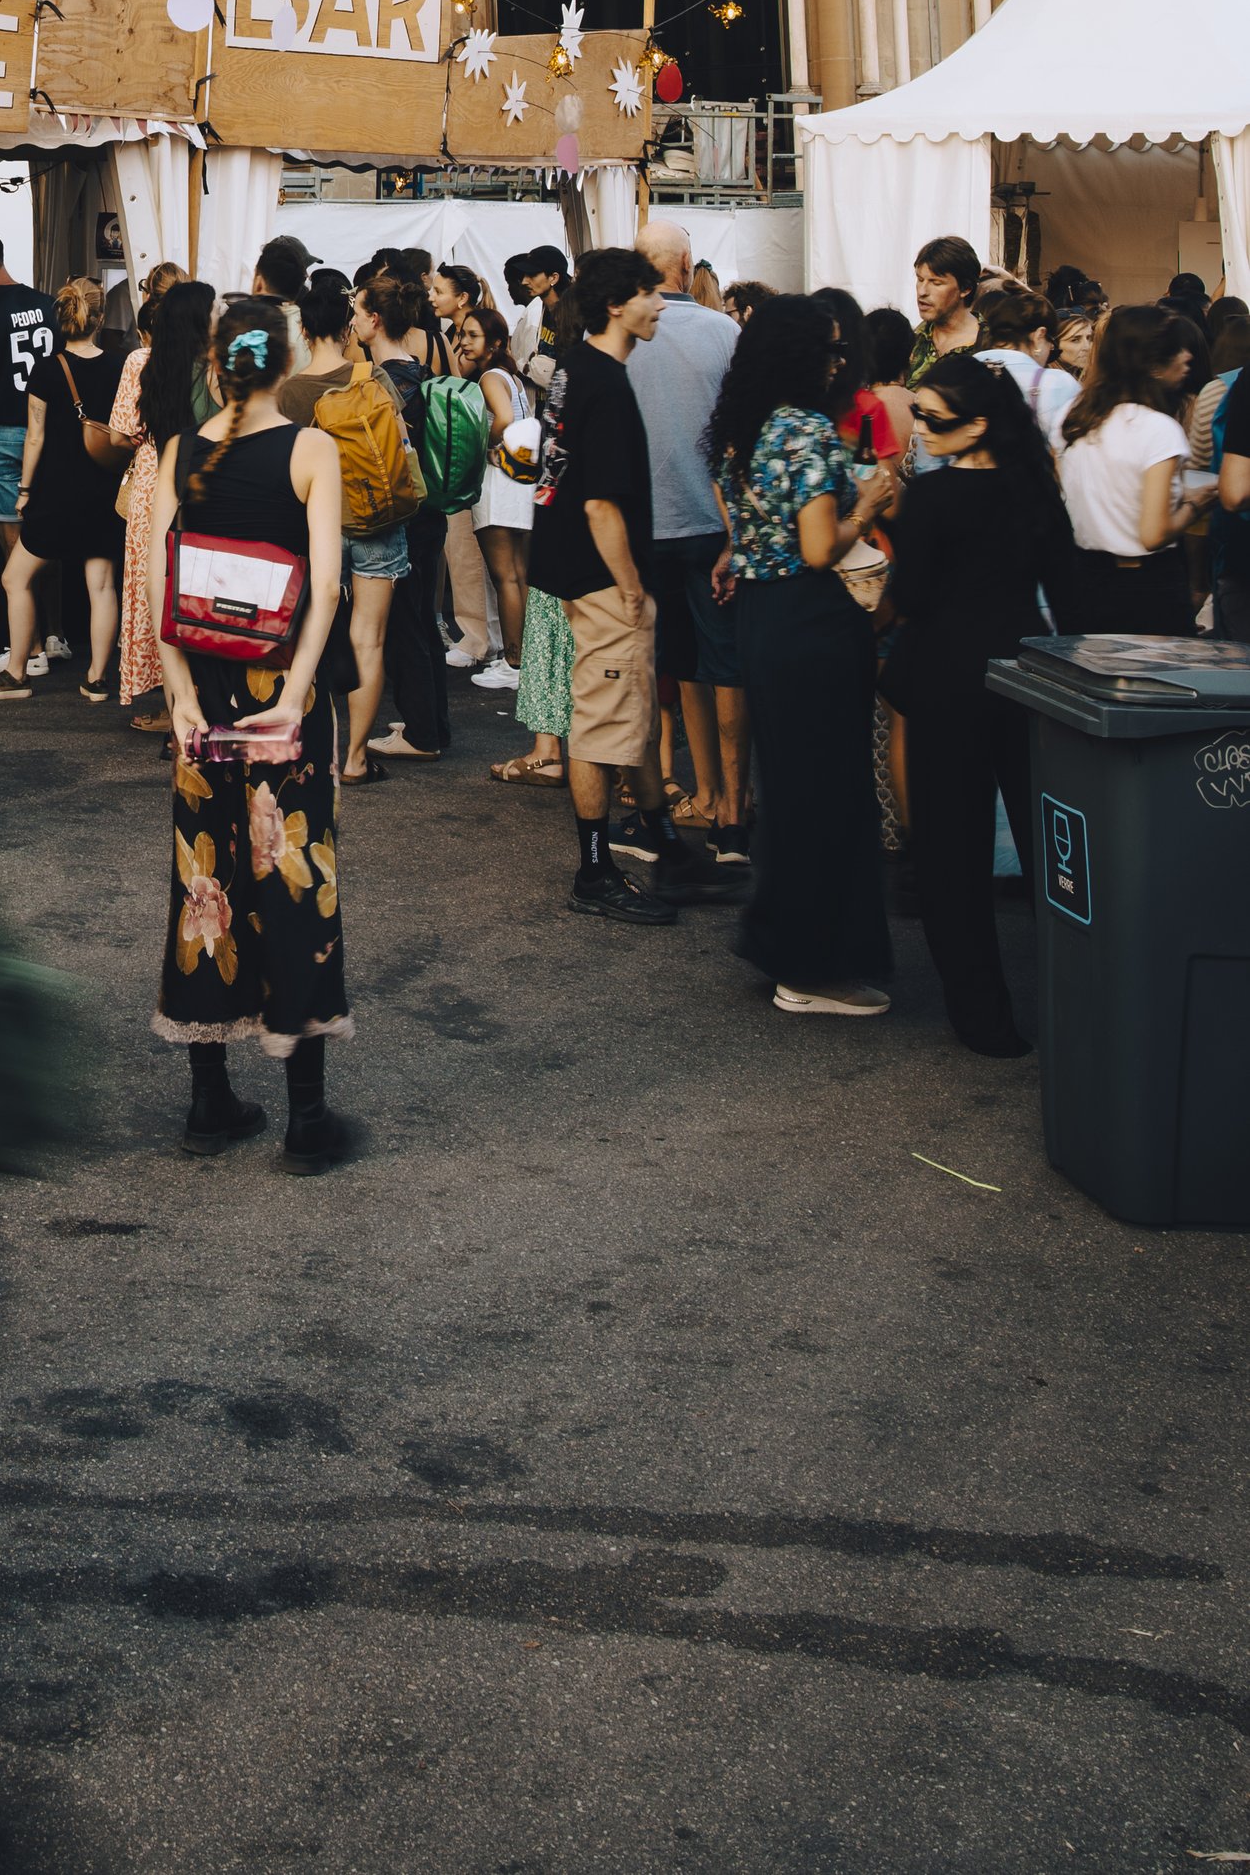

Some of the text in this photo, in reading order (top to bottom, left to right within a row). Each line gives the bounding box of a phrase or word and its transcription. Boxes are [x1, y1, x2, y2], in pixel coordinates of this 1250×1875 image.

[11, 308, 44, 328] PEDRO
[591, 831, 599, 864] SALOMON
[1058, 874, 1074, 894] VERRE
